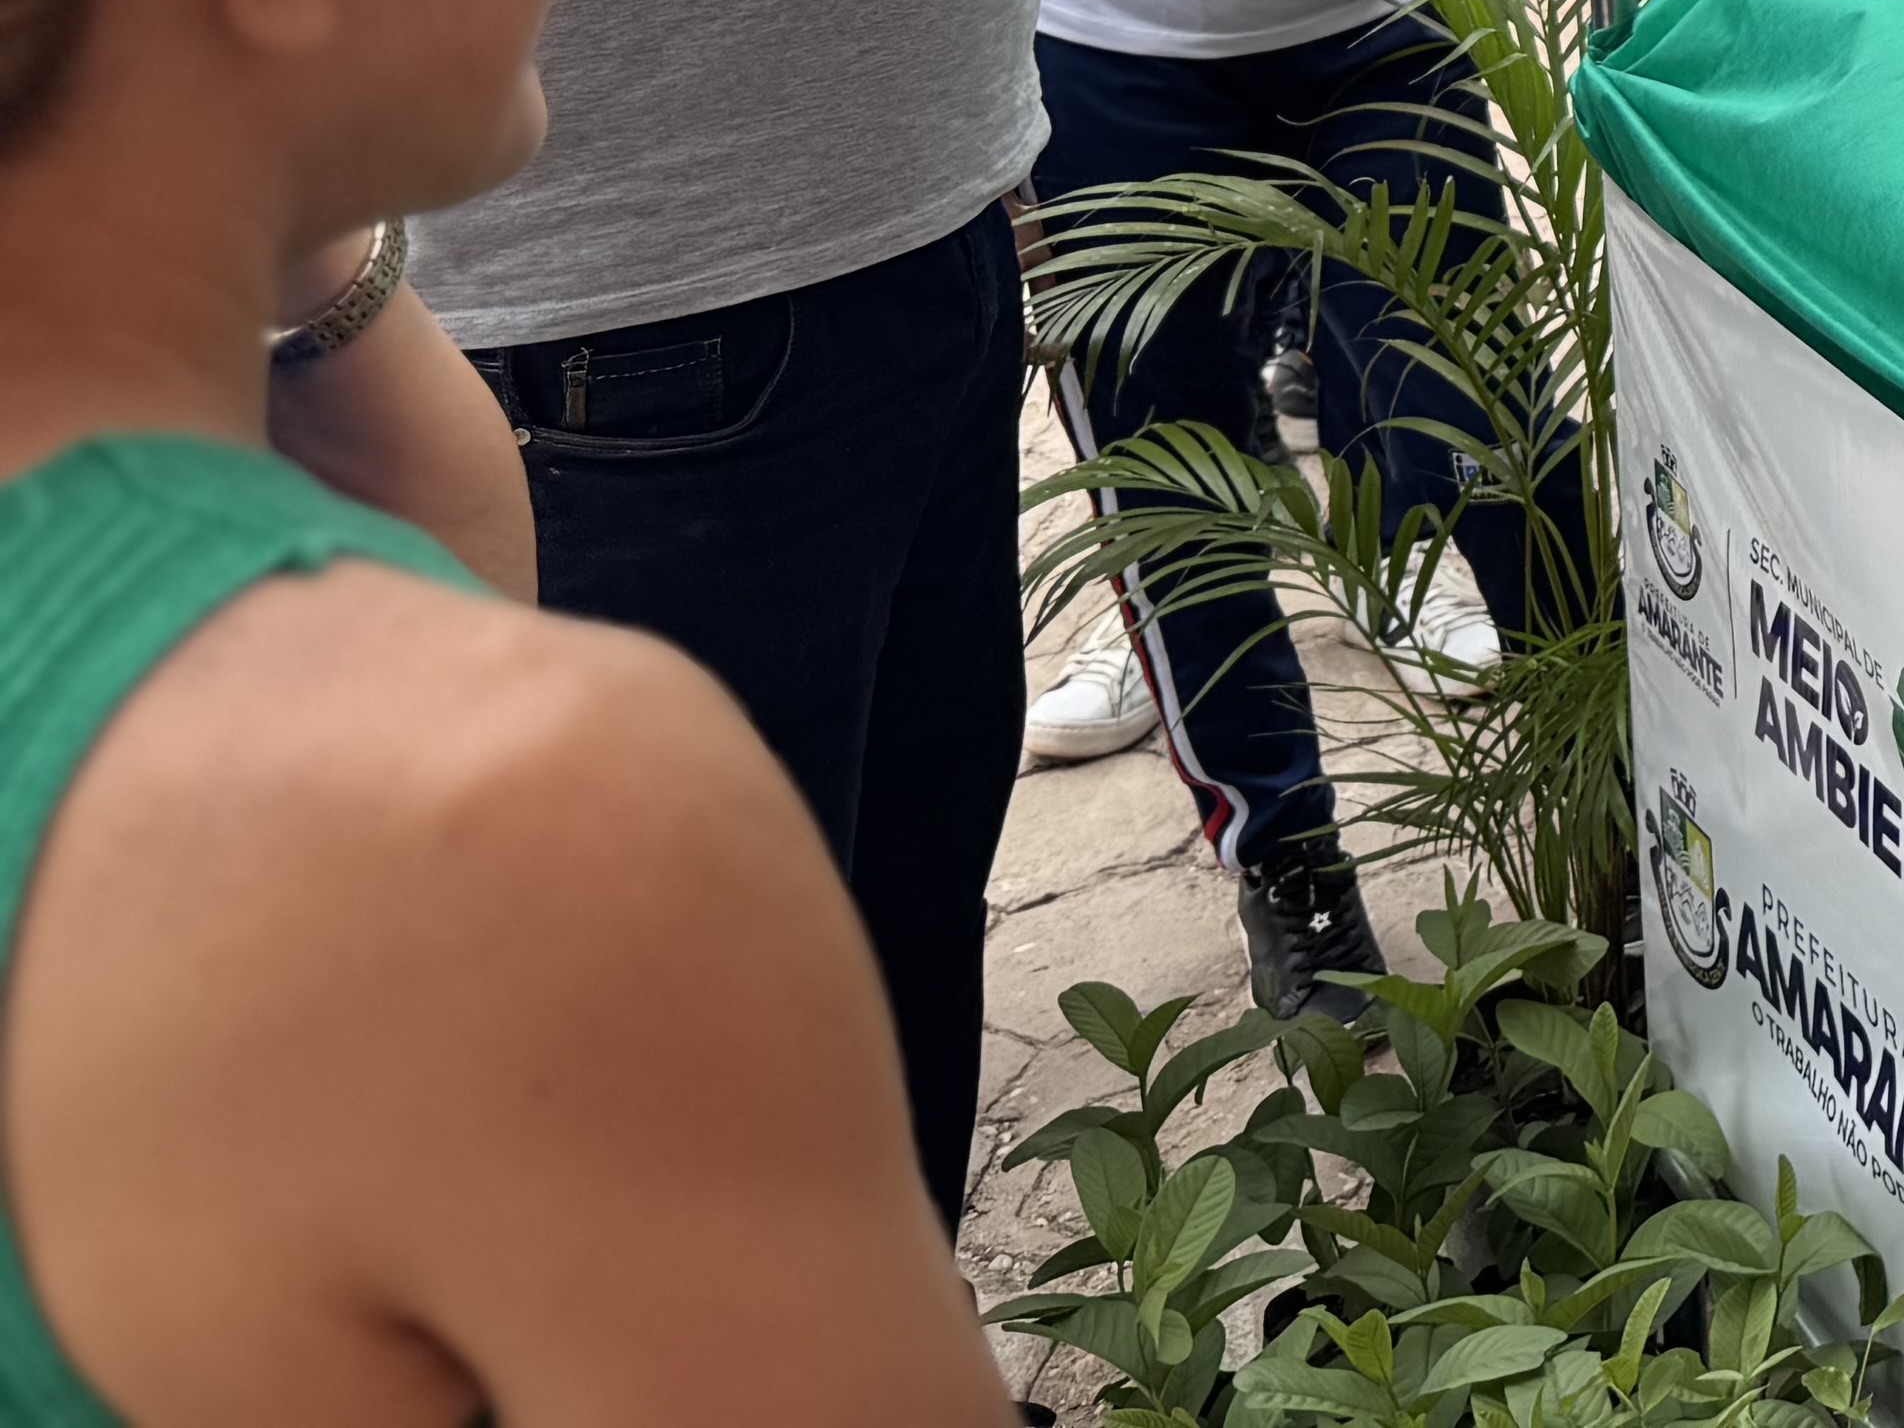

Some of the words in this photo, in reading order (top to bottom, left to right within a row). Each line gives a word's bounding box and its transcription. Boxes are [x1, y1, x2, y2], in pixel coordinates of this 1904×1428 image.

[1638, 585, 1724, 700] AMARANTE
[1749, 537, 1783, 585] SEC.
[1786, 565, 1863, 667] MUNICIPAL
[1863, 648, 1885, 691] DE
[1750, 578, 1870, 746] MEIO
[1751, 1001, 1764, 1026] O
[1766, 1012, 1837, 1123] TRABALHO
[1838, 1114, 1868, 1168] NÃO
